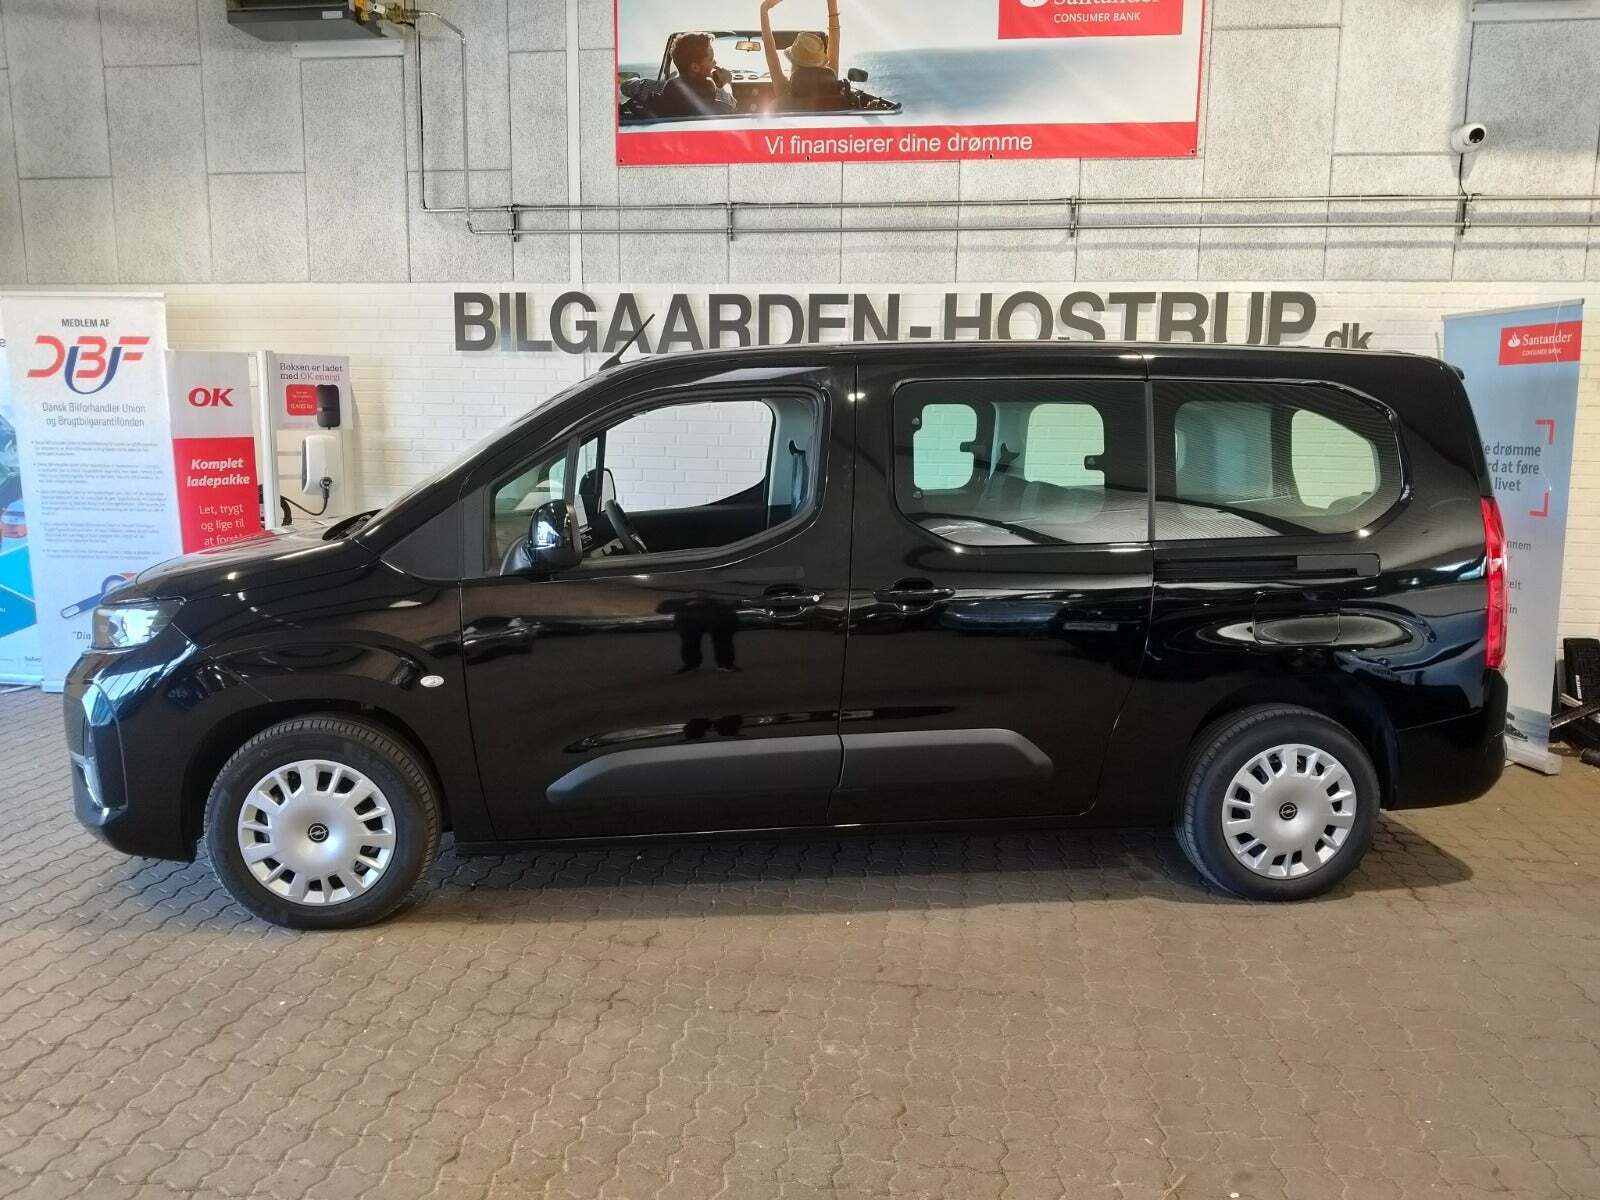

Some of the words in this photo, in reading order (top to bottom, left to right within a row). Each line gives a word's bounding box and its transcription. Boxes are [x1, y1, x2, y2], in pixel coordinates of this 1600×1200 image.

[1054, 12, 1110, 24] CONSUMER
[1113, 11, 1141, 22] BANK
[764, 135, 784, 155] Vi
[790, 134, 893, 155] finansierer
[899, 133, 941, 153] dine
[947, 131, 1033, 152] drømme
[61, 318, 98, 328] MEDLEM
[99, 318, 111, 328] AF
[1522, 329, 1573, 346] Santander
[279, 362, 310, 372] Boksen
[322, 363, 343, 373] ladet
[280, 371, 299, 380] med
[300, 372, 314, 381] OK
[188, 387, 235, 408] OK
[43, 402, 68, 413] Dansk
[69, 402, 120, 414] Bilforhandler
[122, 403, 146, 414] Union
[46, 418, 57, 427] og
[1492, 441, 1542, 457] drømme
[191, 458, 244, 473] Komplet
[1501, 462, 1514, 474] at
[1516, 460, 1540, 475] føre
[187, 473, 250, 489] ladepakke
[199, 504, 218, 516] Let,
[220, 503, 244, 516] trygt
[200, 522, 214, 533] og
[215, 519, 233, 532] lige
[235, 518, 245, 529] til
[203, 536, 215, 547] at
